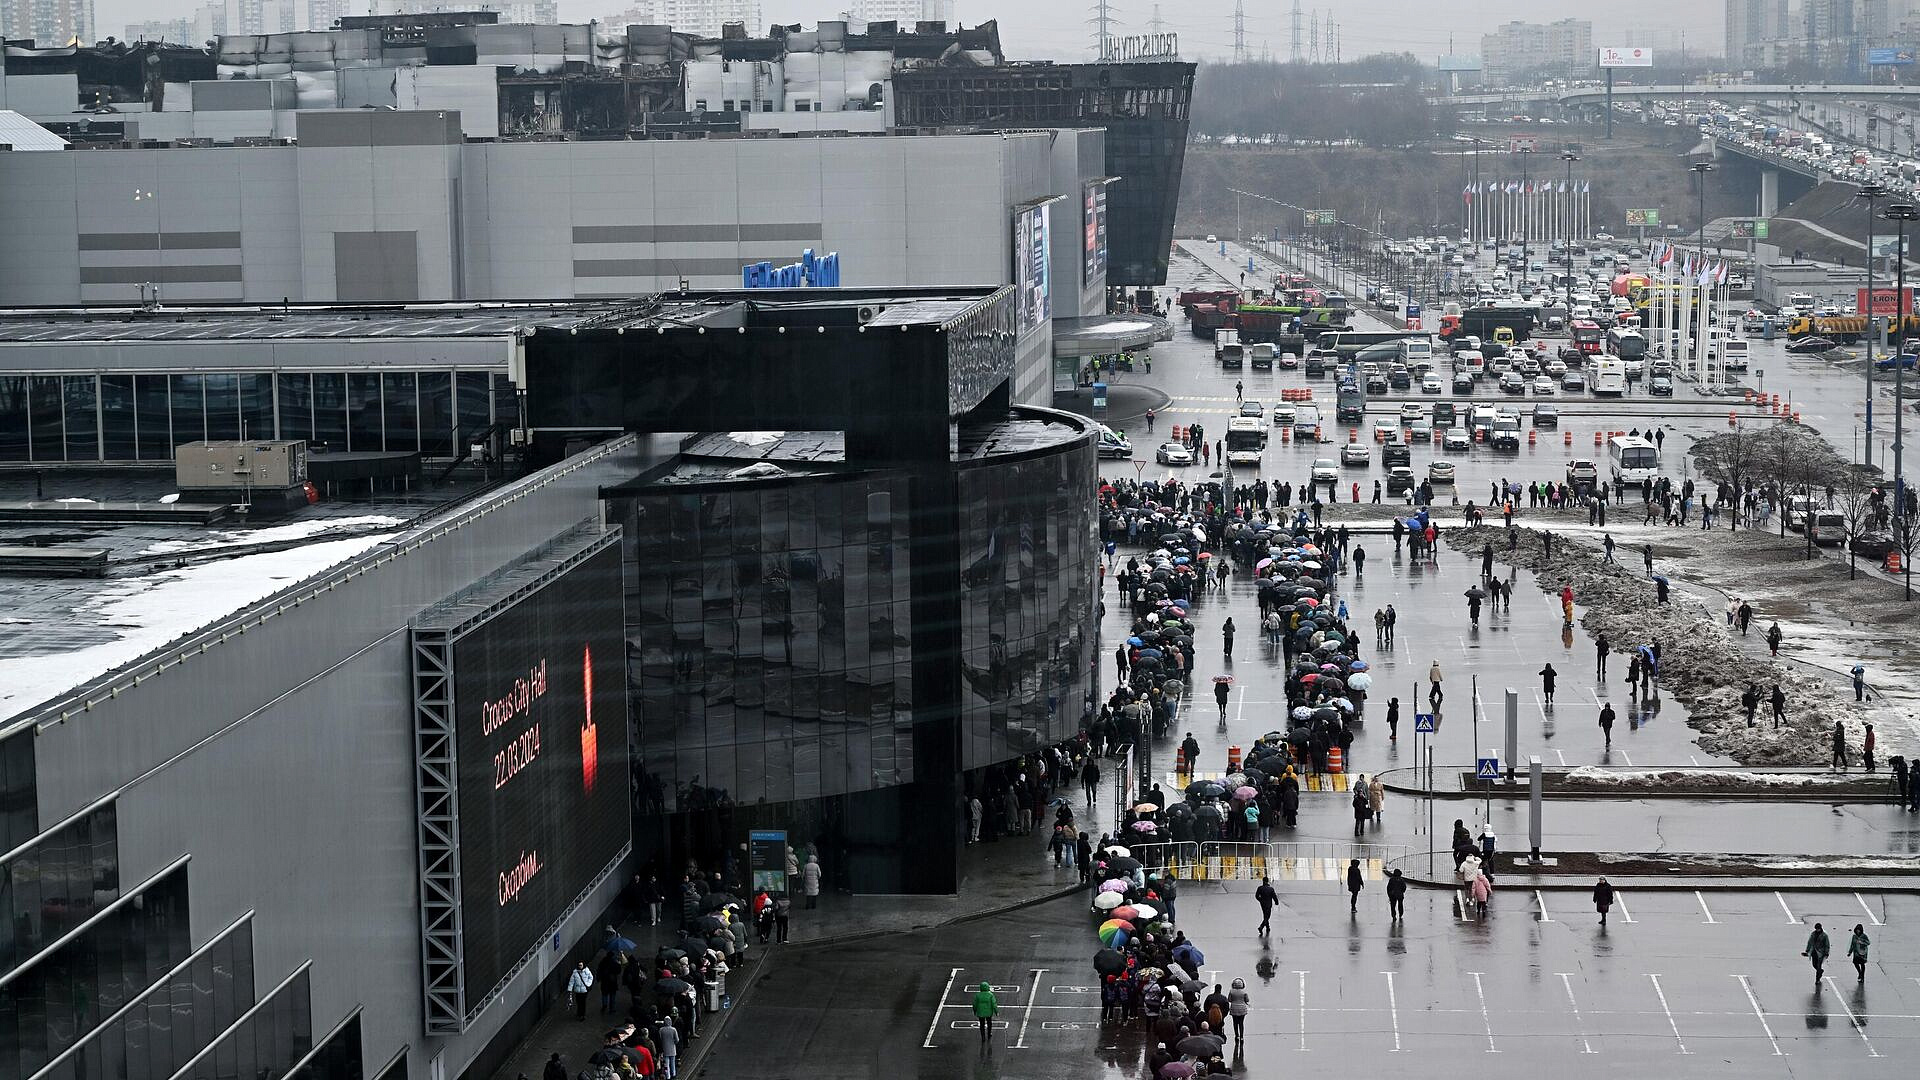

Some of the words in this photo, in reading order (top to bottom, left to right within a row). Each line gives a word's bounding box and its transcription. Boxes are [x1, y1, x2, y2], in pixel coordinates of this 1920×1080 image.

[482, 692, 513, 736] Crocus
[515, 678, 529, 716] City
[531, 658, 547, 702] Hall
[494, 722, 540, 790] 22.03.2024
